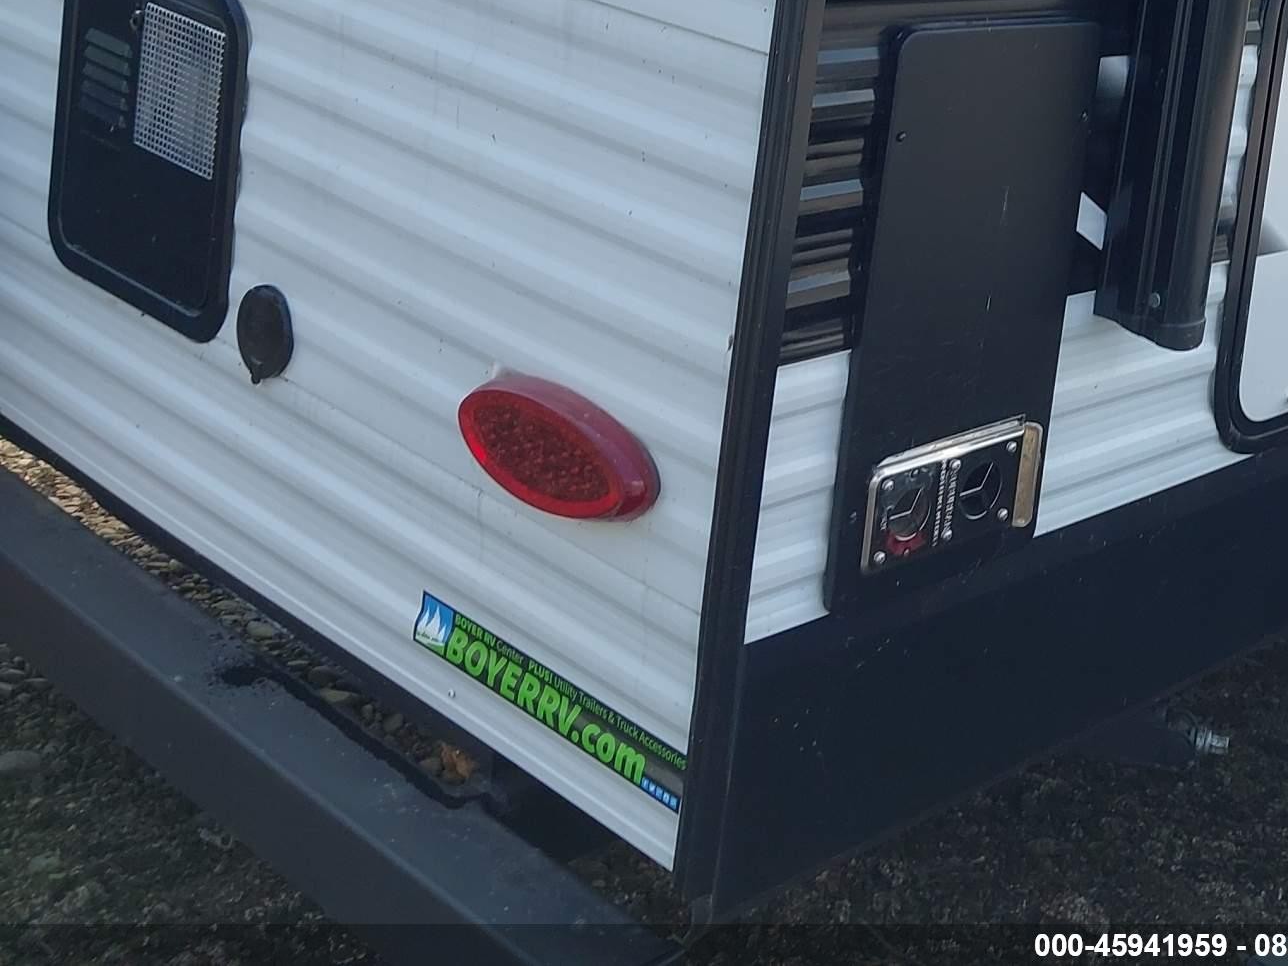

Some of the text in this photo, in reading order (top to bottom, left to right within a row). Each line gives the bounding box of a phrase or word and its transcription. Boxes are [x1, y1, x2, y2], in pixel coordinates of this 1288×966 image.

[446, 626, 647, 785] BOYERRV.com
[455, 614, 482, 640] BOYER
[496, 640, 524, 665] Center
[554, 675, 578, 702] Utility
[579, 690, 608, 719] Trailers
[616, 716, 641, 741] Truck
[640, 731, 688, 771] Accessories
